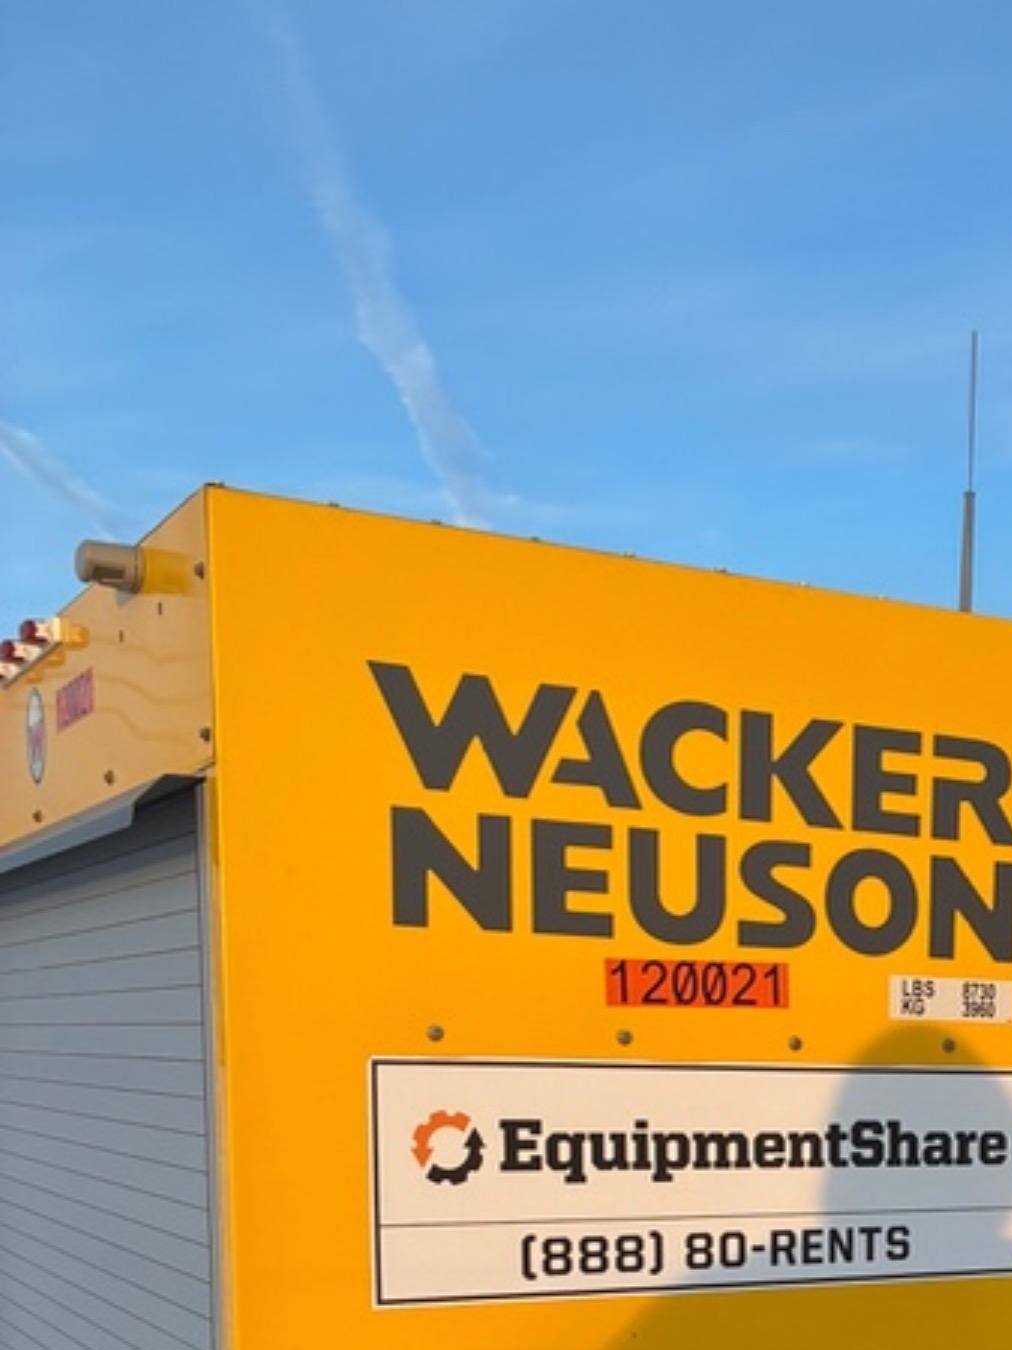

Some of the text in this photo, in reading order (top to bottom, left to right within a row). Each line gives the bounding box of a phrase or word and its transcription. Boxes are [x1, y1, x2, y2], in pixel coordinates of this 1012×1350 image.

[610, 959, 782, 1006] 120021
[901, 978, 935, 997] LBS
[900, 998, 926, 1016] KG
[500, 1119, 1007, 1183] EquipmentShare
[520, 1225, 911, 1281] (888) 80-RENTS
